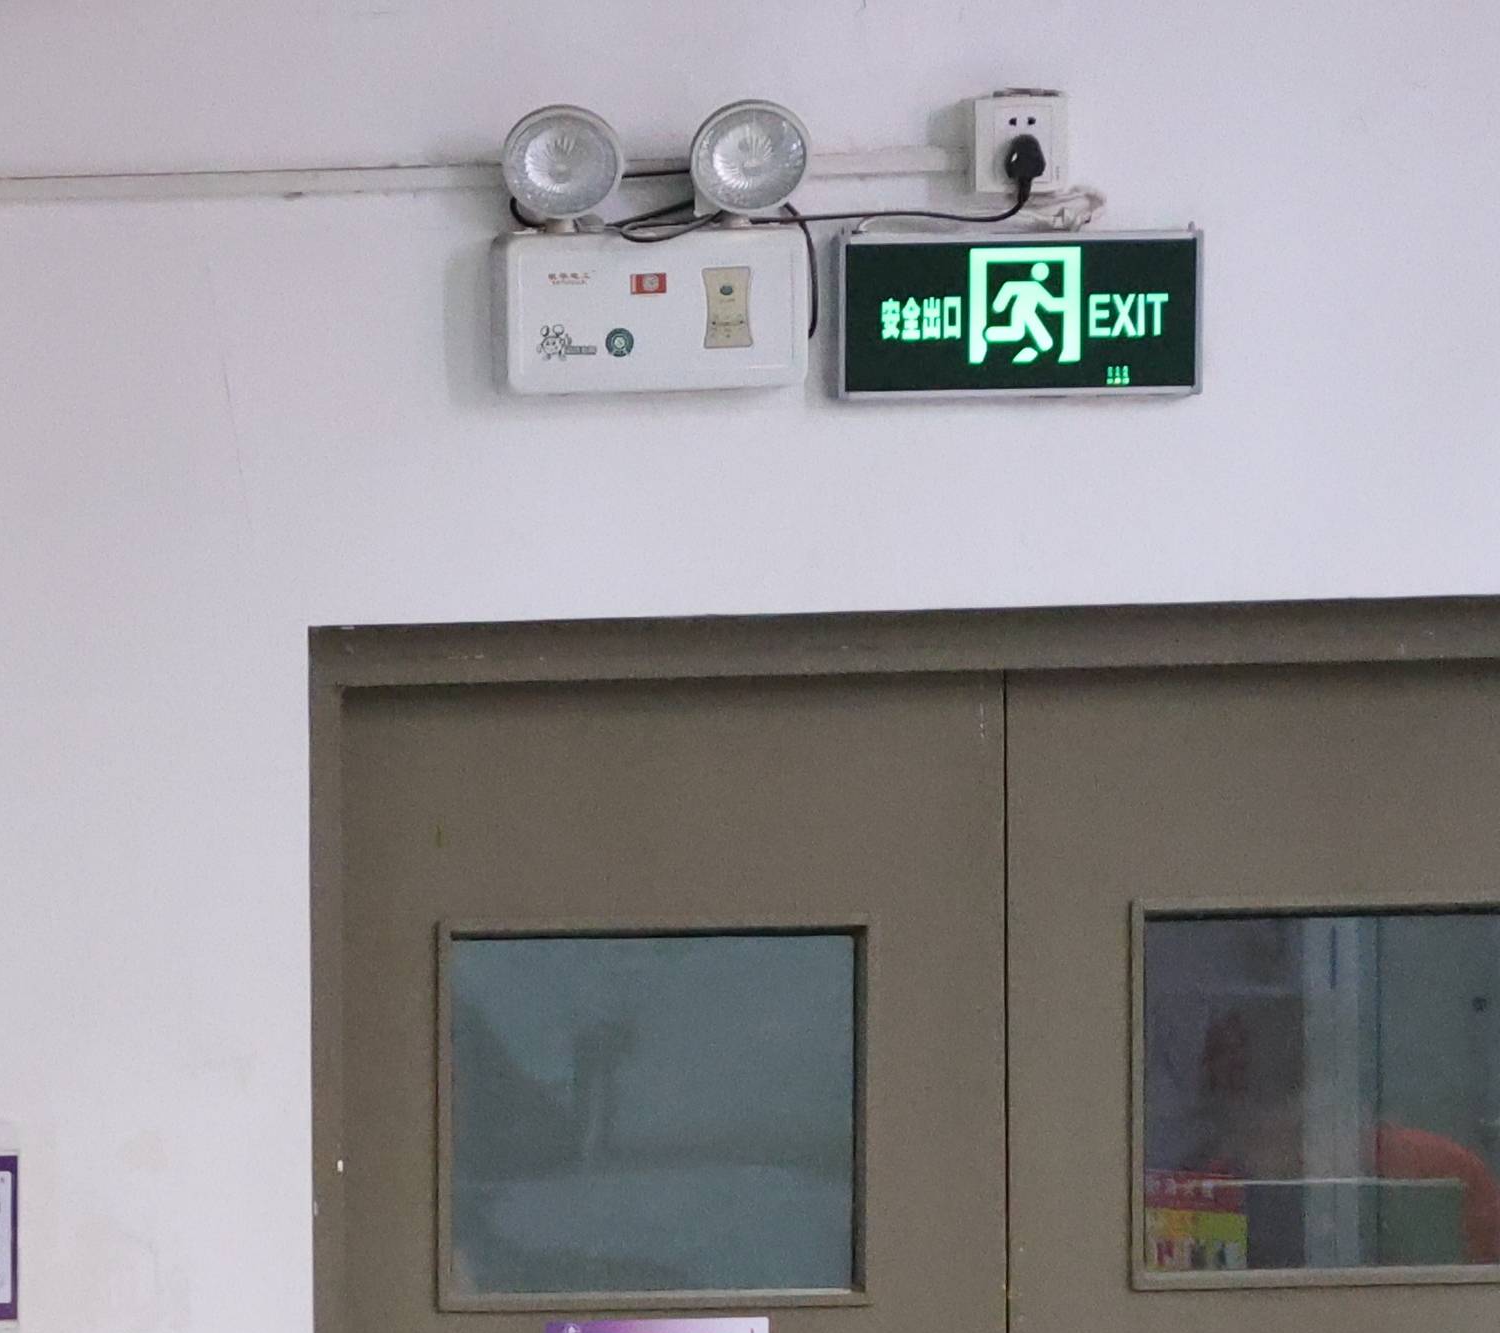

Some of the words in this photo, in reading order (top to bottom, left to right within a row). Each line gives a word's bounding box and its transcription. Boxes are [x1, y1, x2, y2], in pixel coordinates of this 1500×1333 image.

[882, 297, 962, 341] 安全出口
[1089, 294, 1170, 338] EXIT
